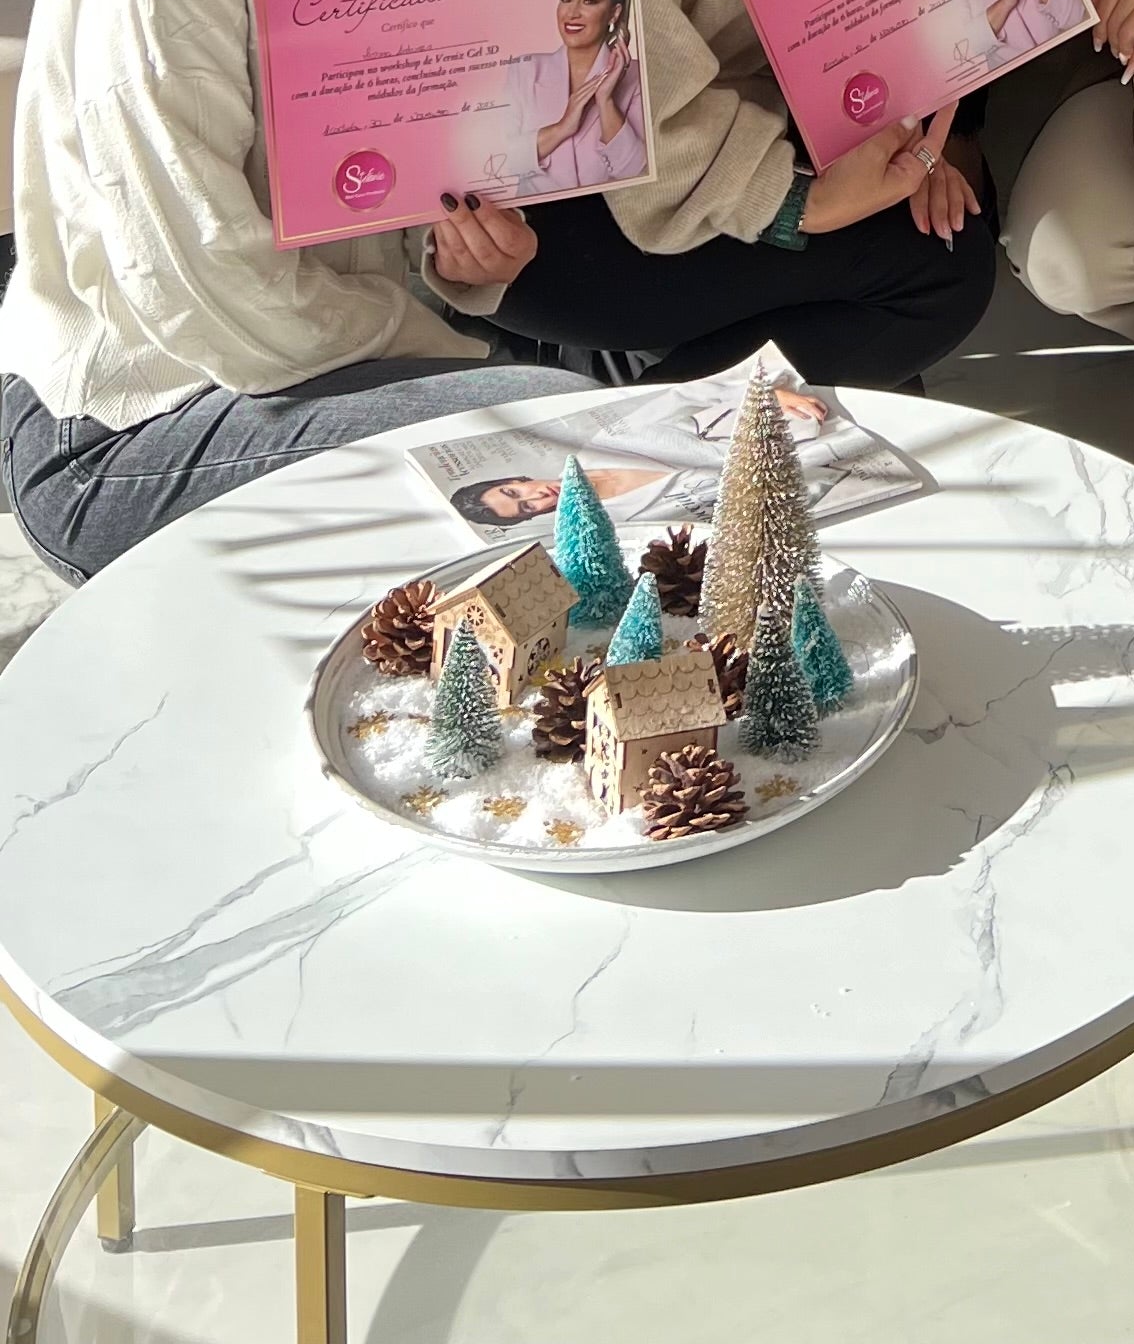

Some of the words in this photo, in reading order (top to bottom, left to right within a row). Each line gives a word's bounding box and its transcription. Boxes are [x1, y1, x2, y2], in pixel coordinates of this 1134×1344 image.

[381, 19, 418, 32] Certifico
[420, 19, 435, 30] que
[322, 70, 365, 82] Participou
[380, 59, 421, 72] workshop
[423, 55, 433, 65] de
[436, 53, 464, 63] Verniz
[467, 47, 483, 58] Gel
[486, 45, 500, 55] 3D
[291, 92, 309, 100] com
[355, 80, 365, 90] de
[449, 66, 466, 75] com
[523, 54, 533, 62] os
[406, 85, 416, 95] da
[393, 113, 404, 123] de
[461, 102, 471, 112] de
